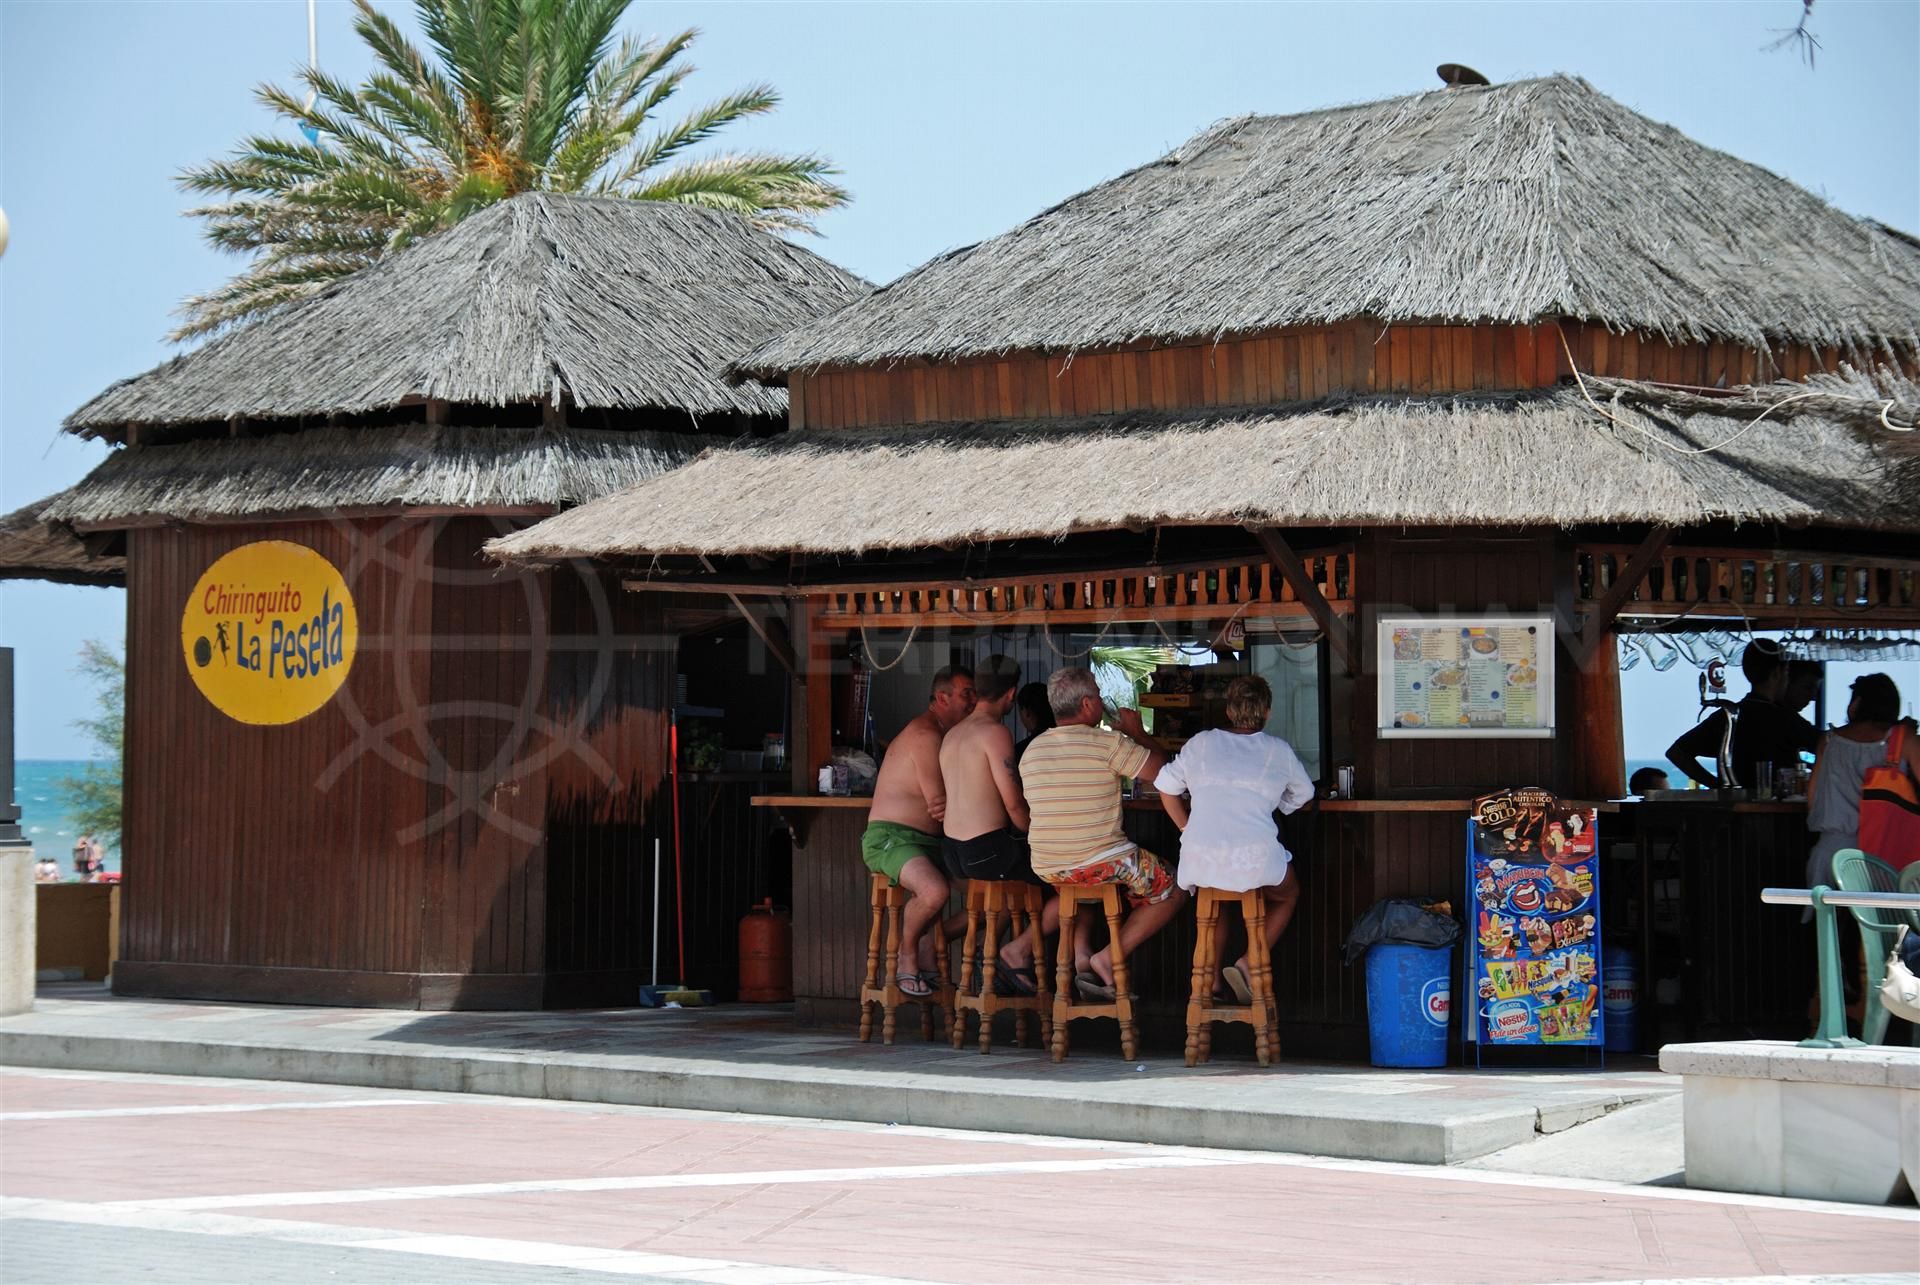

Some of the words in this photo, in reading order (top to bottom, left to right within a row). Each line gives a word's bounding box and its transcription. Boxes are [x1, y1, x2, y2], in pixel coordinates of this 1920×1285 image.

[204, 582, 302, 624] Chiringuito
[237, 621, 261, 672] La
[268, 586, 343, 679] Peseta
[1480, 807, 1517, 825] GOLD
